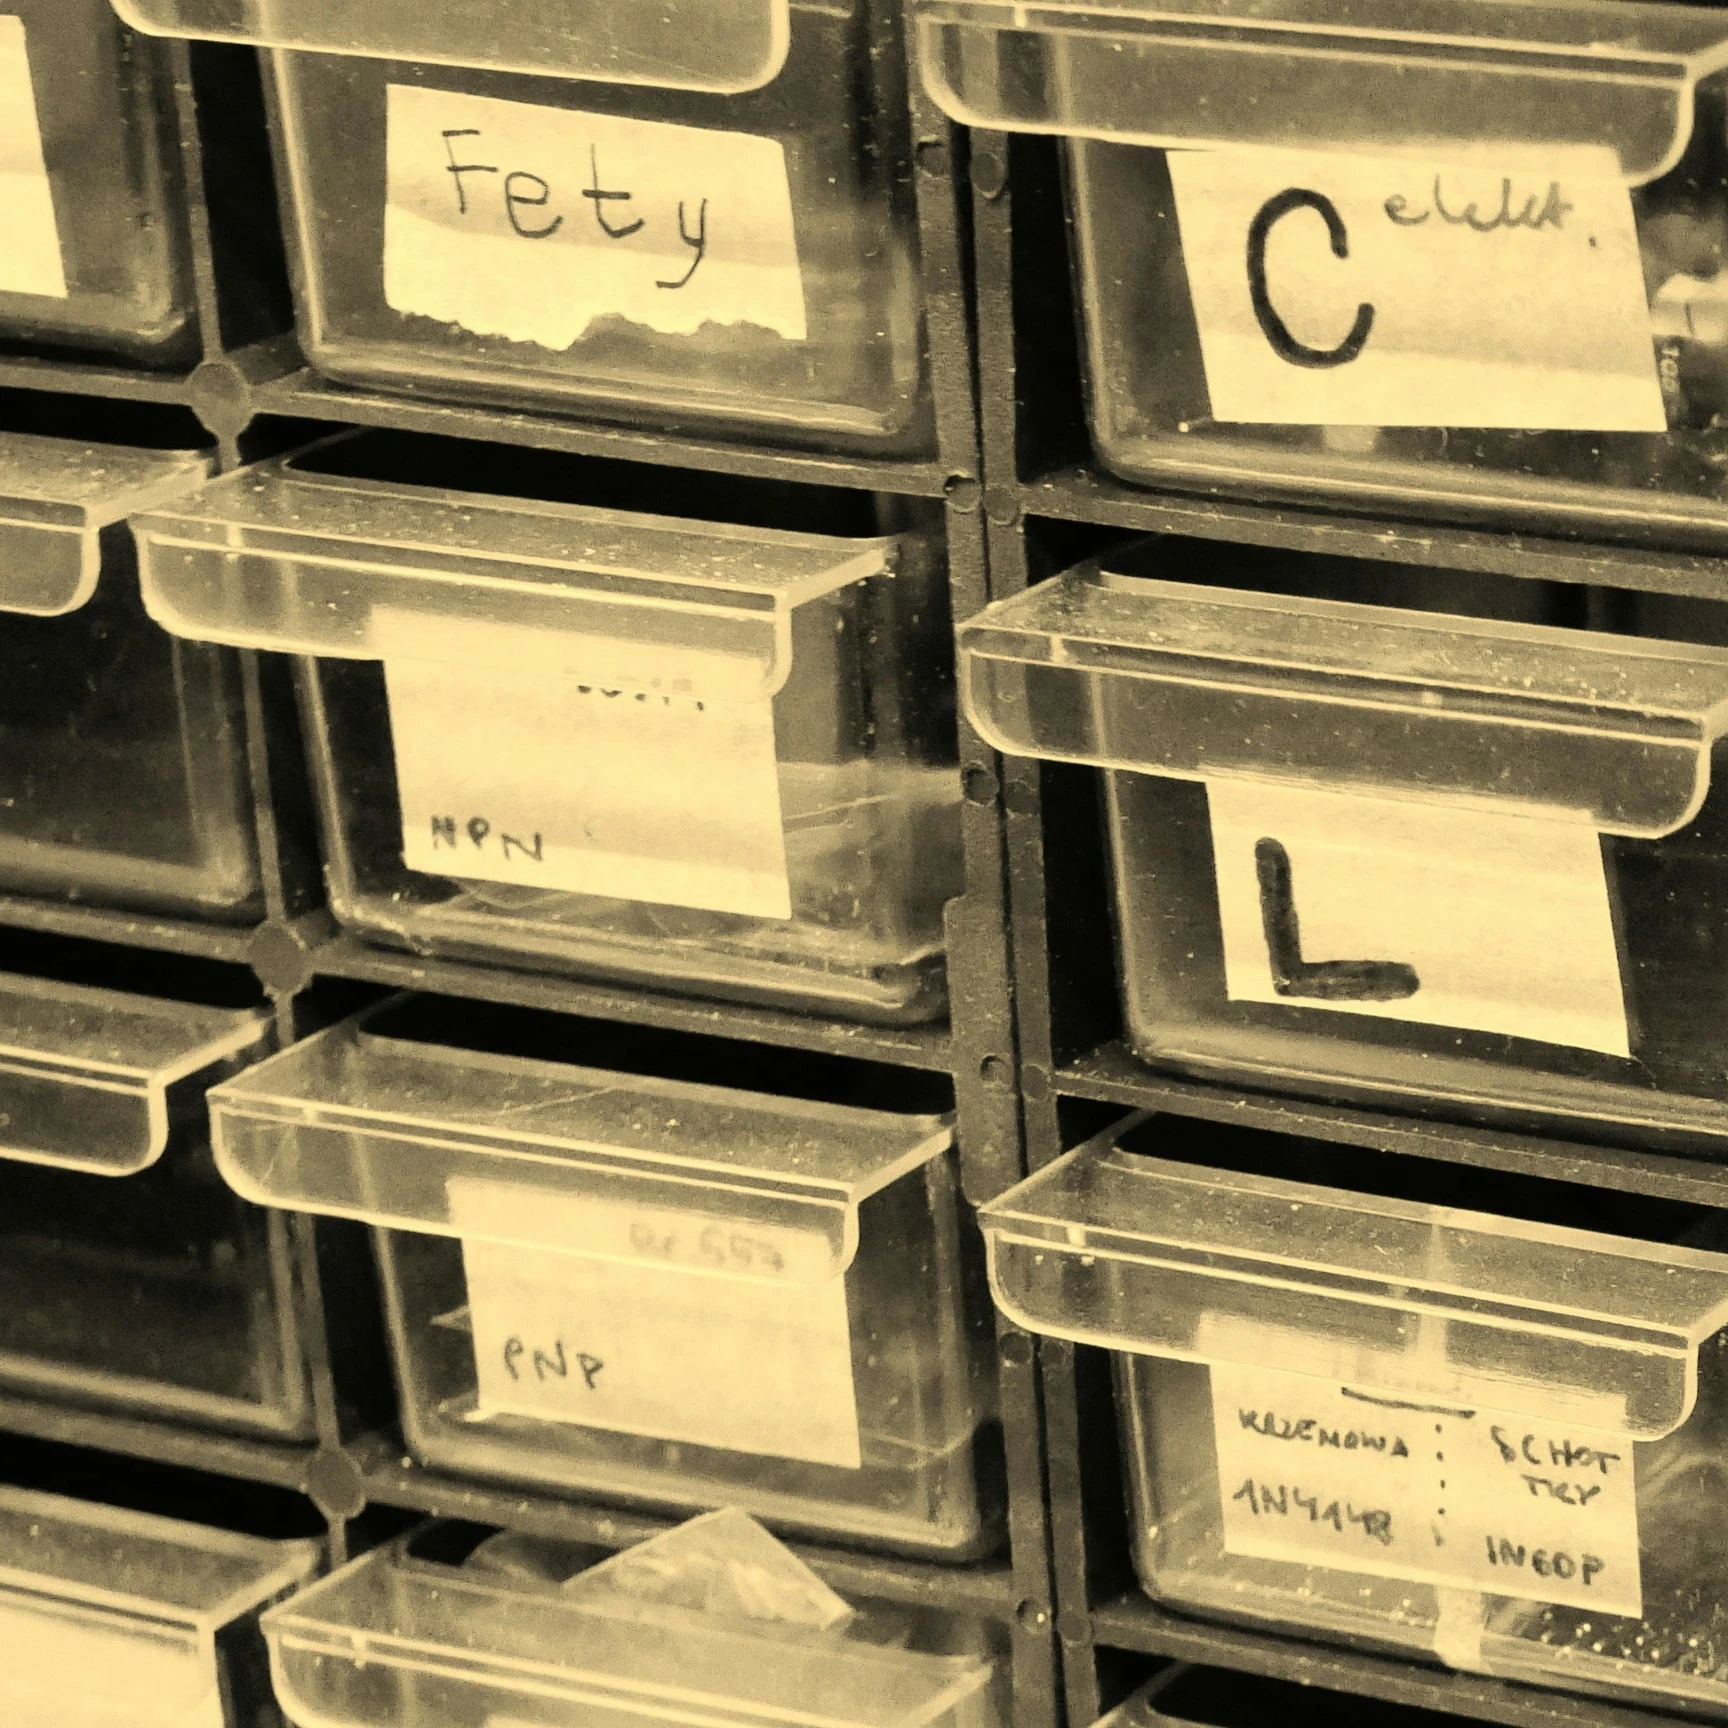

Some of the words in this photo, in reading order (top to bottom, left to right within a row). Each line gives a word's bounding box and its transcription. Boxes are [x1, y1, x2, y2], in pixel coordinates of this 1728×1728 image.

[442, 128, 709, 289] Fety
[1246, 187, 1375, 368] C
[1254, 836, 1420, 1001] L
[504, 1335, 604, 1389] PNP
